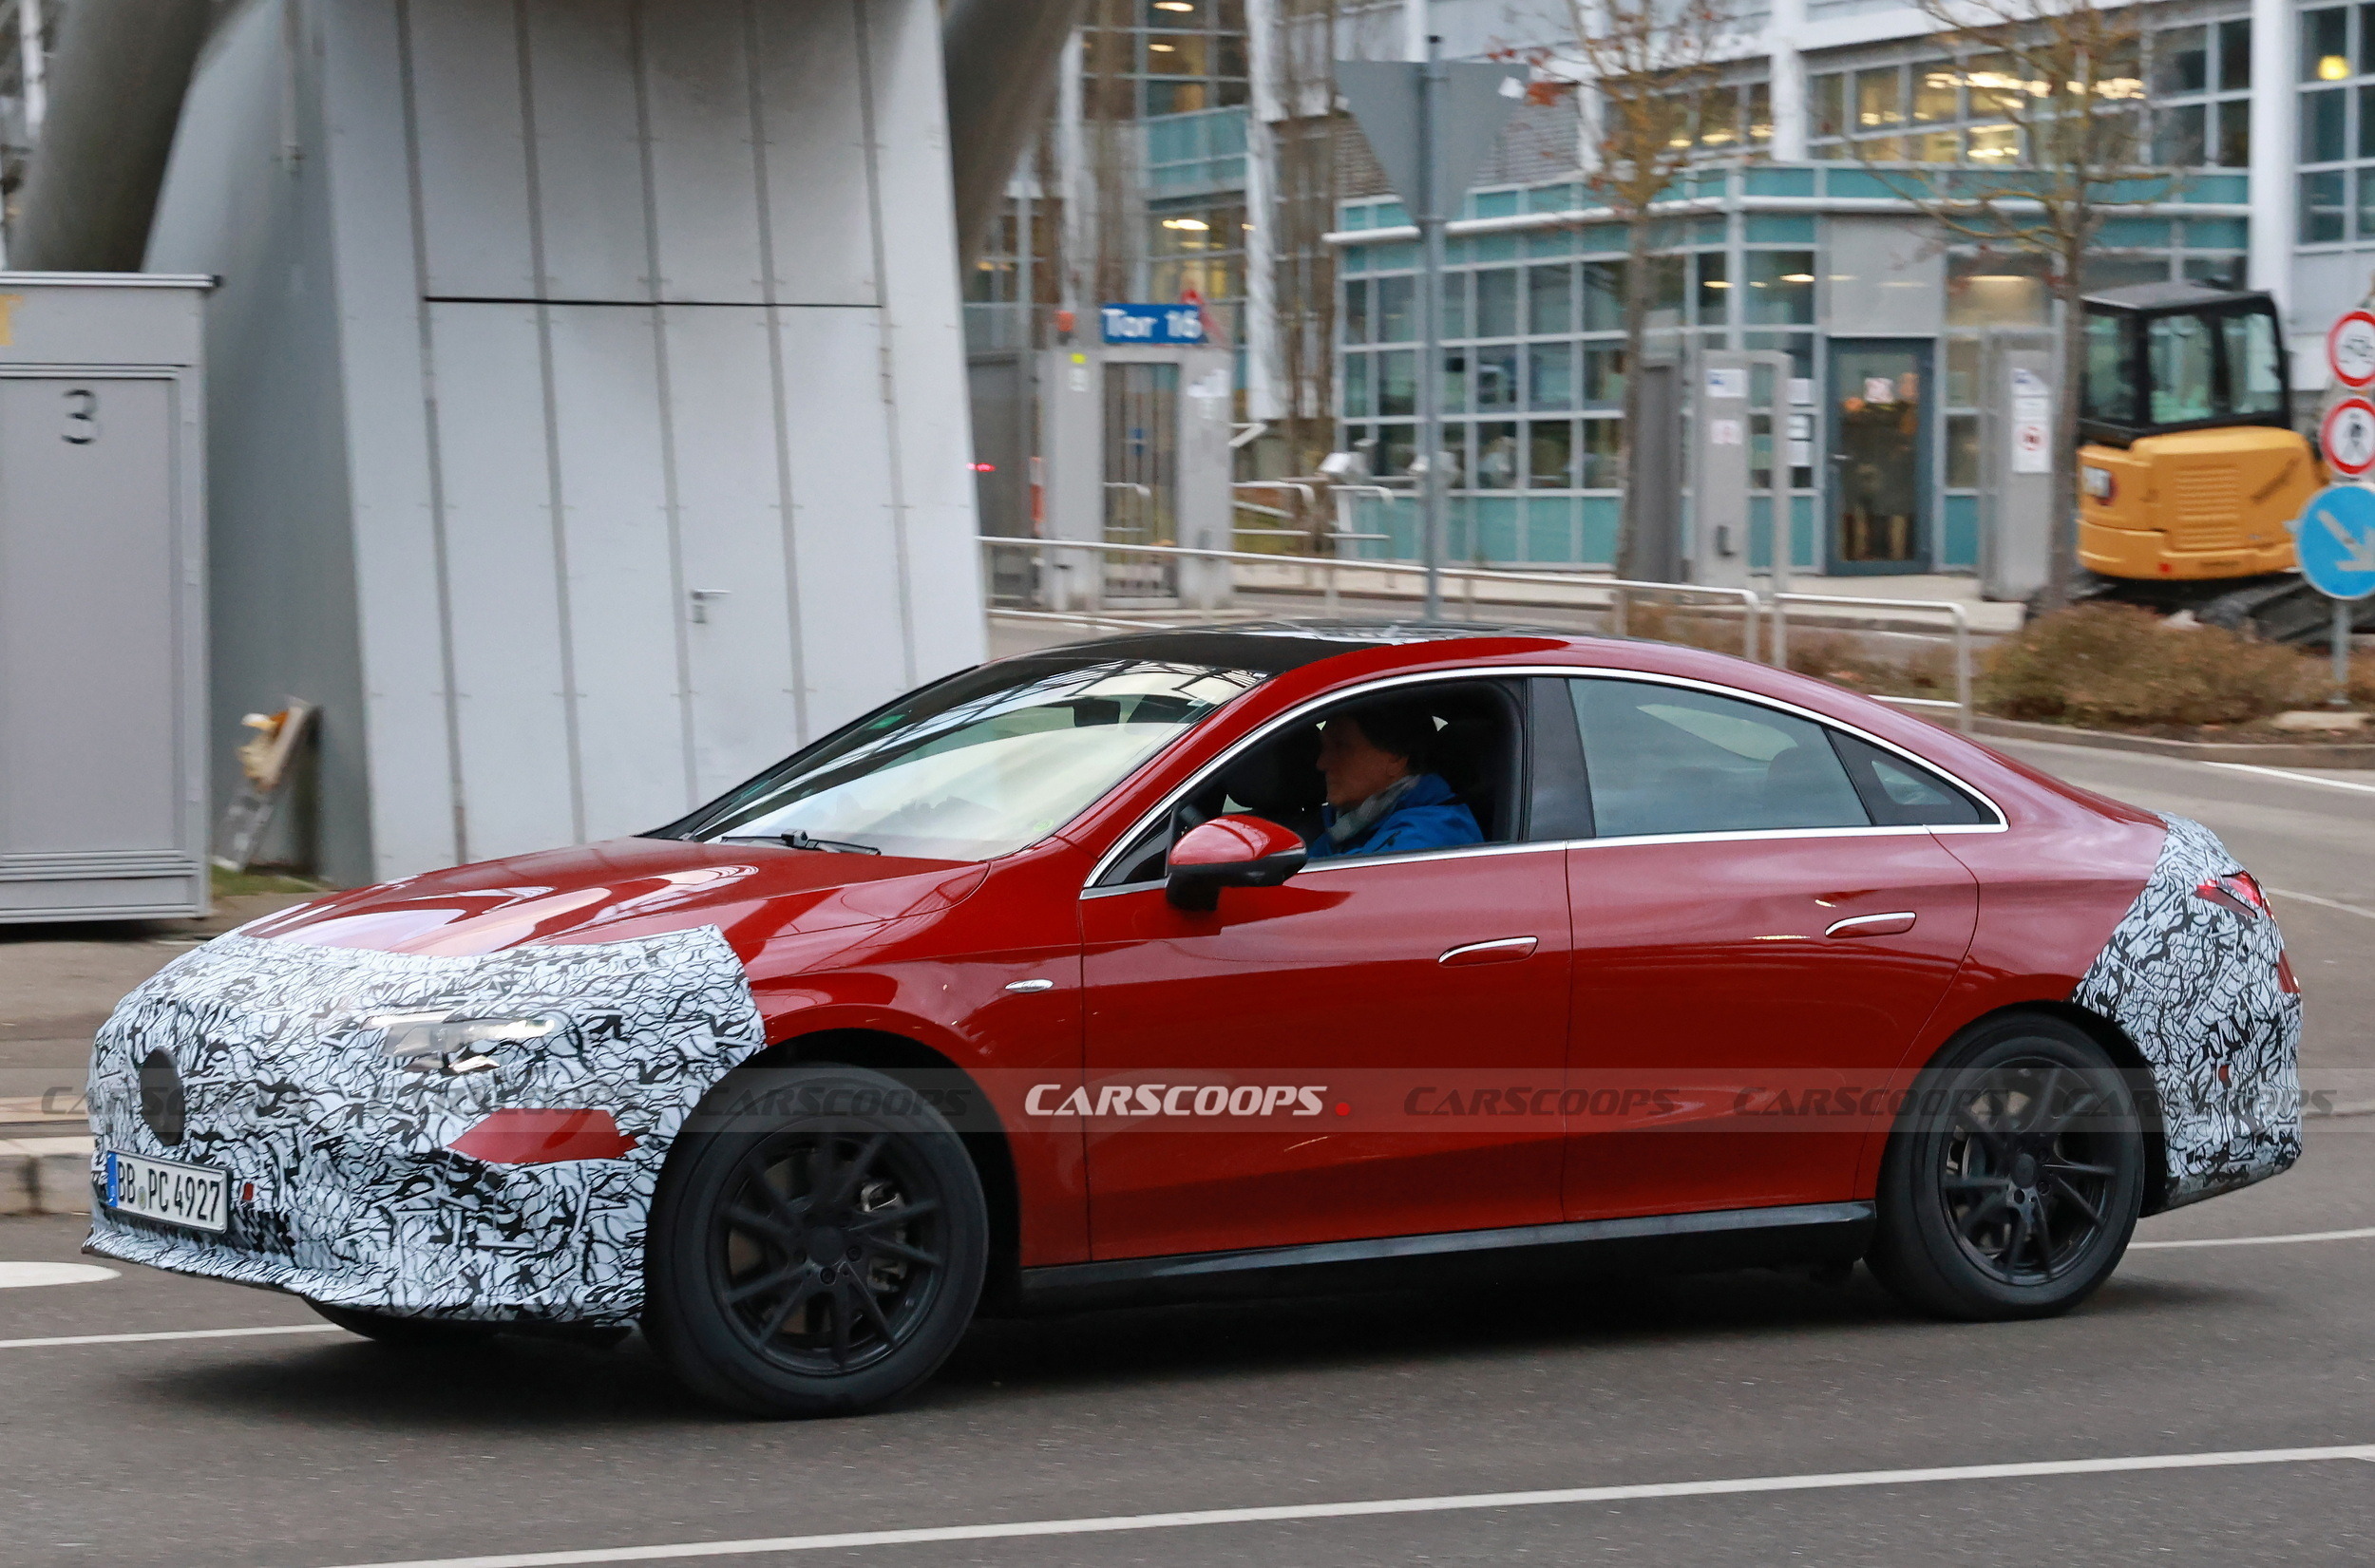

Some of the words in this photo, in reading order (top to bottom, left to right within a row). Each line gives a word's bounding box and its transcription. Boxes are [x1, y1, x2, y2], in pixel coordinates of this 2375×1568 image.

[1101, 308, 1158, 338] Tor
[61, 388, 100, 445] 3
[117, 1161, 136, 1204] BB
[148, 1168, 169, 1213] PC
[174, 1174, 220, 1222] 4927
